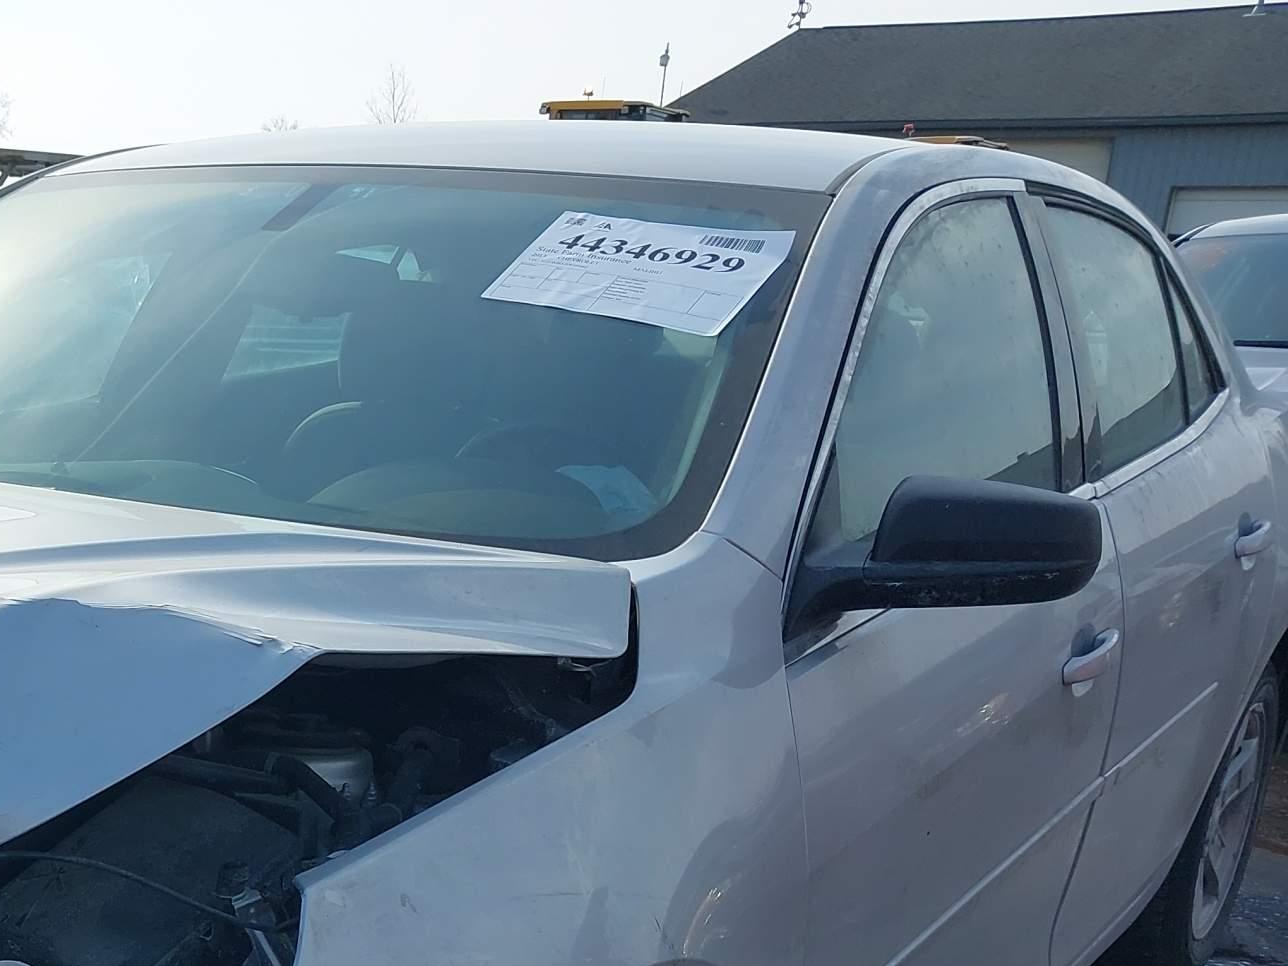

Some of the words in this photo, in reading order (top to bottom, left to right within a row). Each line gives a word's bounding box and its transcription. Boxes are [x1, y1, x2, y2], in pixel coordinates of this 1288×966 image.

[536, 246, 558, 254] State
[561, 248, 585, 257] Farm
[587, 253, 633, 265] Insurance
[558, 233, 746, 273] 44346929
